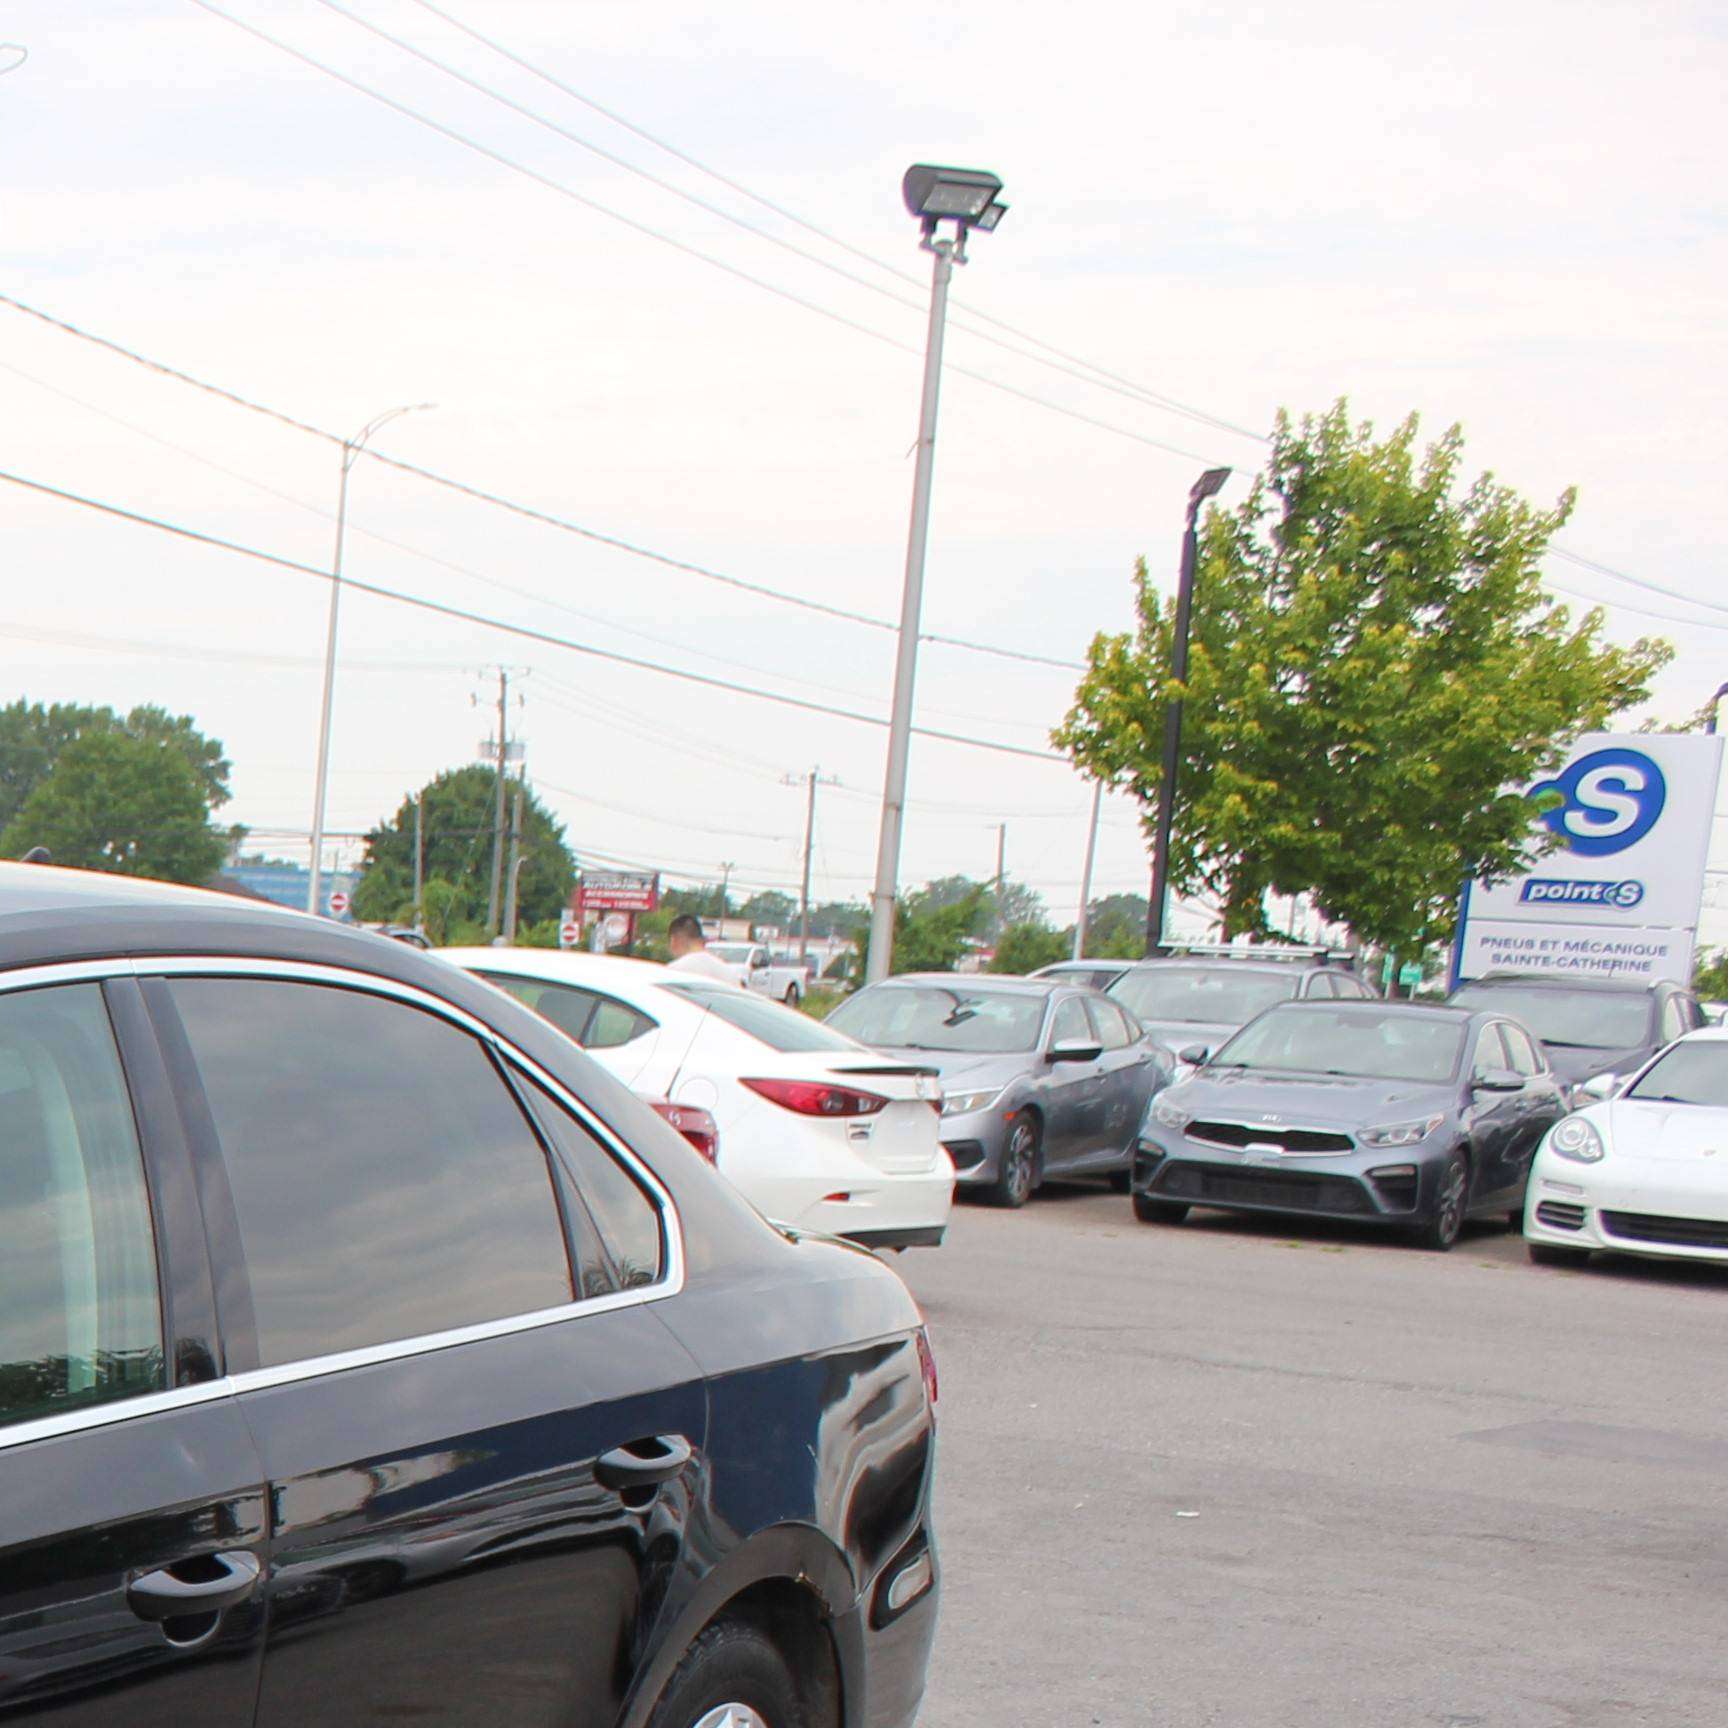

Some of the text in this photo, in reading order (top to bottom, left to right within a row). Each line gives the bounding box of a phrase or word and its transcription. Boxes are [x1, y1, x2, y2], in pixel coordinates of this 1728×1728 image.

[1563, 765, 1646, 838] S
[1527, 882, 1604, 901] point
[1480, 937, 1669, 957] PNEUS ET MÉCANIQUE
[1491, 953, 1654, 973] SAINTE-CATHERINE
